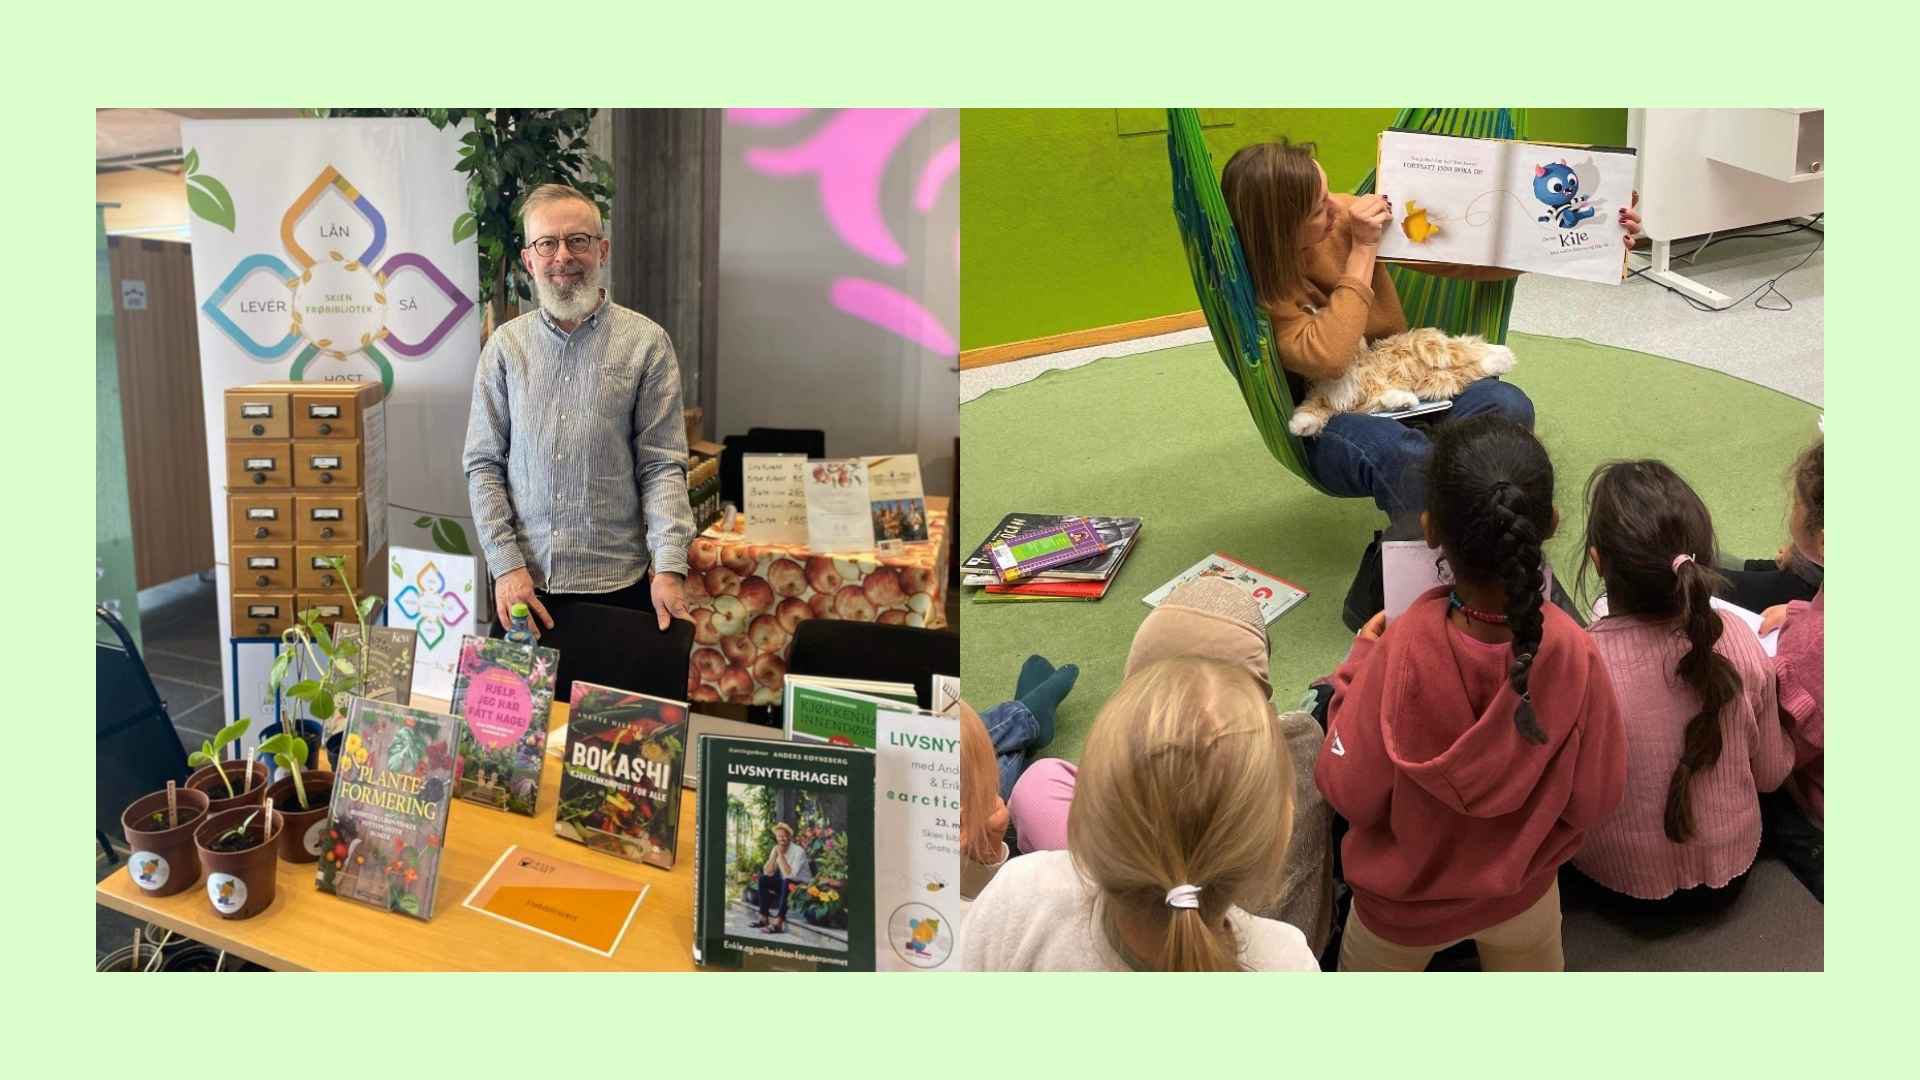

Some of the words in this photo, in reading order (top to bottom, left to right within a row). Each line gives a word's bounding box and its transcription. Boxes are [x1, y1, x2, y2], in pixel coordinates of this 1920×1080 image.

[320, 222, 350, 238] LÅN
[399, 295, 418, 311] SÅ
[890, 731, 960, 753] LIVSNY
[773, 752, 801, 760] ANDERS
[572, 741, 670, 789] BOKASHI
[912, 761, 935, 772] med
[359, 766, 426, 795] PLANTE-
[728, 764, 848, 786] LIVSNYTERHAGEN
[929, 778, 938, 788] &
[340, 781, 437, 820] FORMERING
[633, 786, 647, 797] FOR
[649, 790, 667, 802] ALLE
[936, 817, 949, 828] 23.
